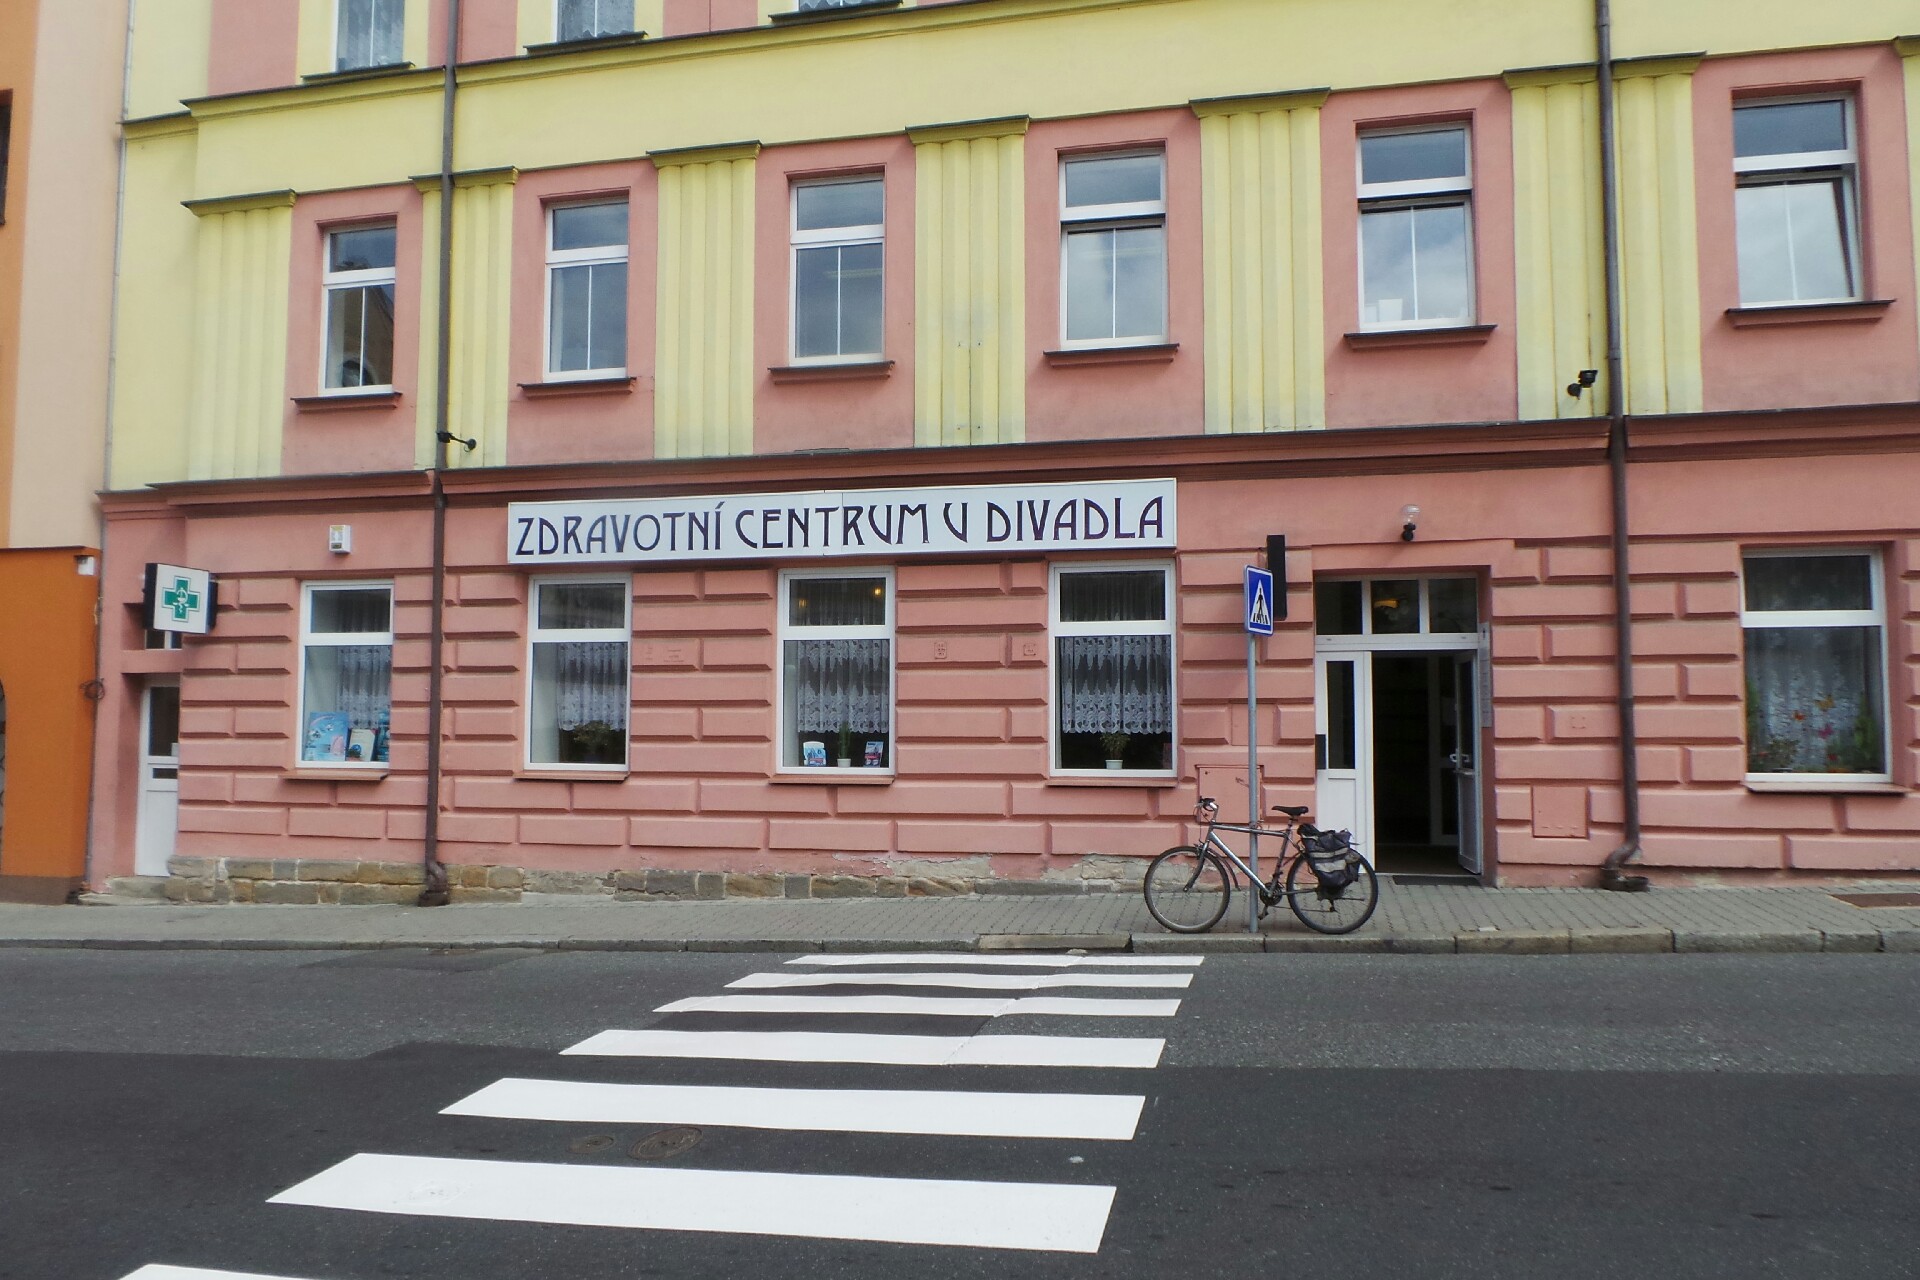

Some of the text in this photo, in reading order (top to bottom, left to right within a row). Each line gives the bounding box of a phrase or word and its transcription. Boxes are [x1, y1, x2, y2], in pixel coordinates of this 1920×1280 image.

[515, 495, 1164, 555] ZDRAVOTNÍ CENTRUM U DIVADLA
